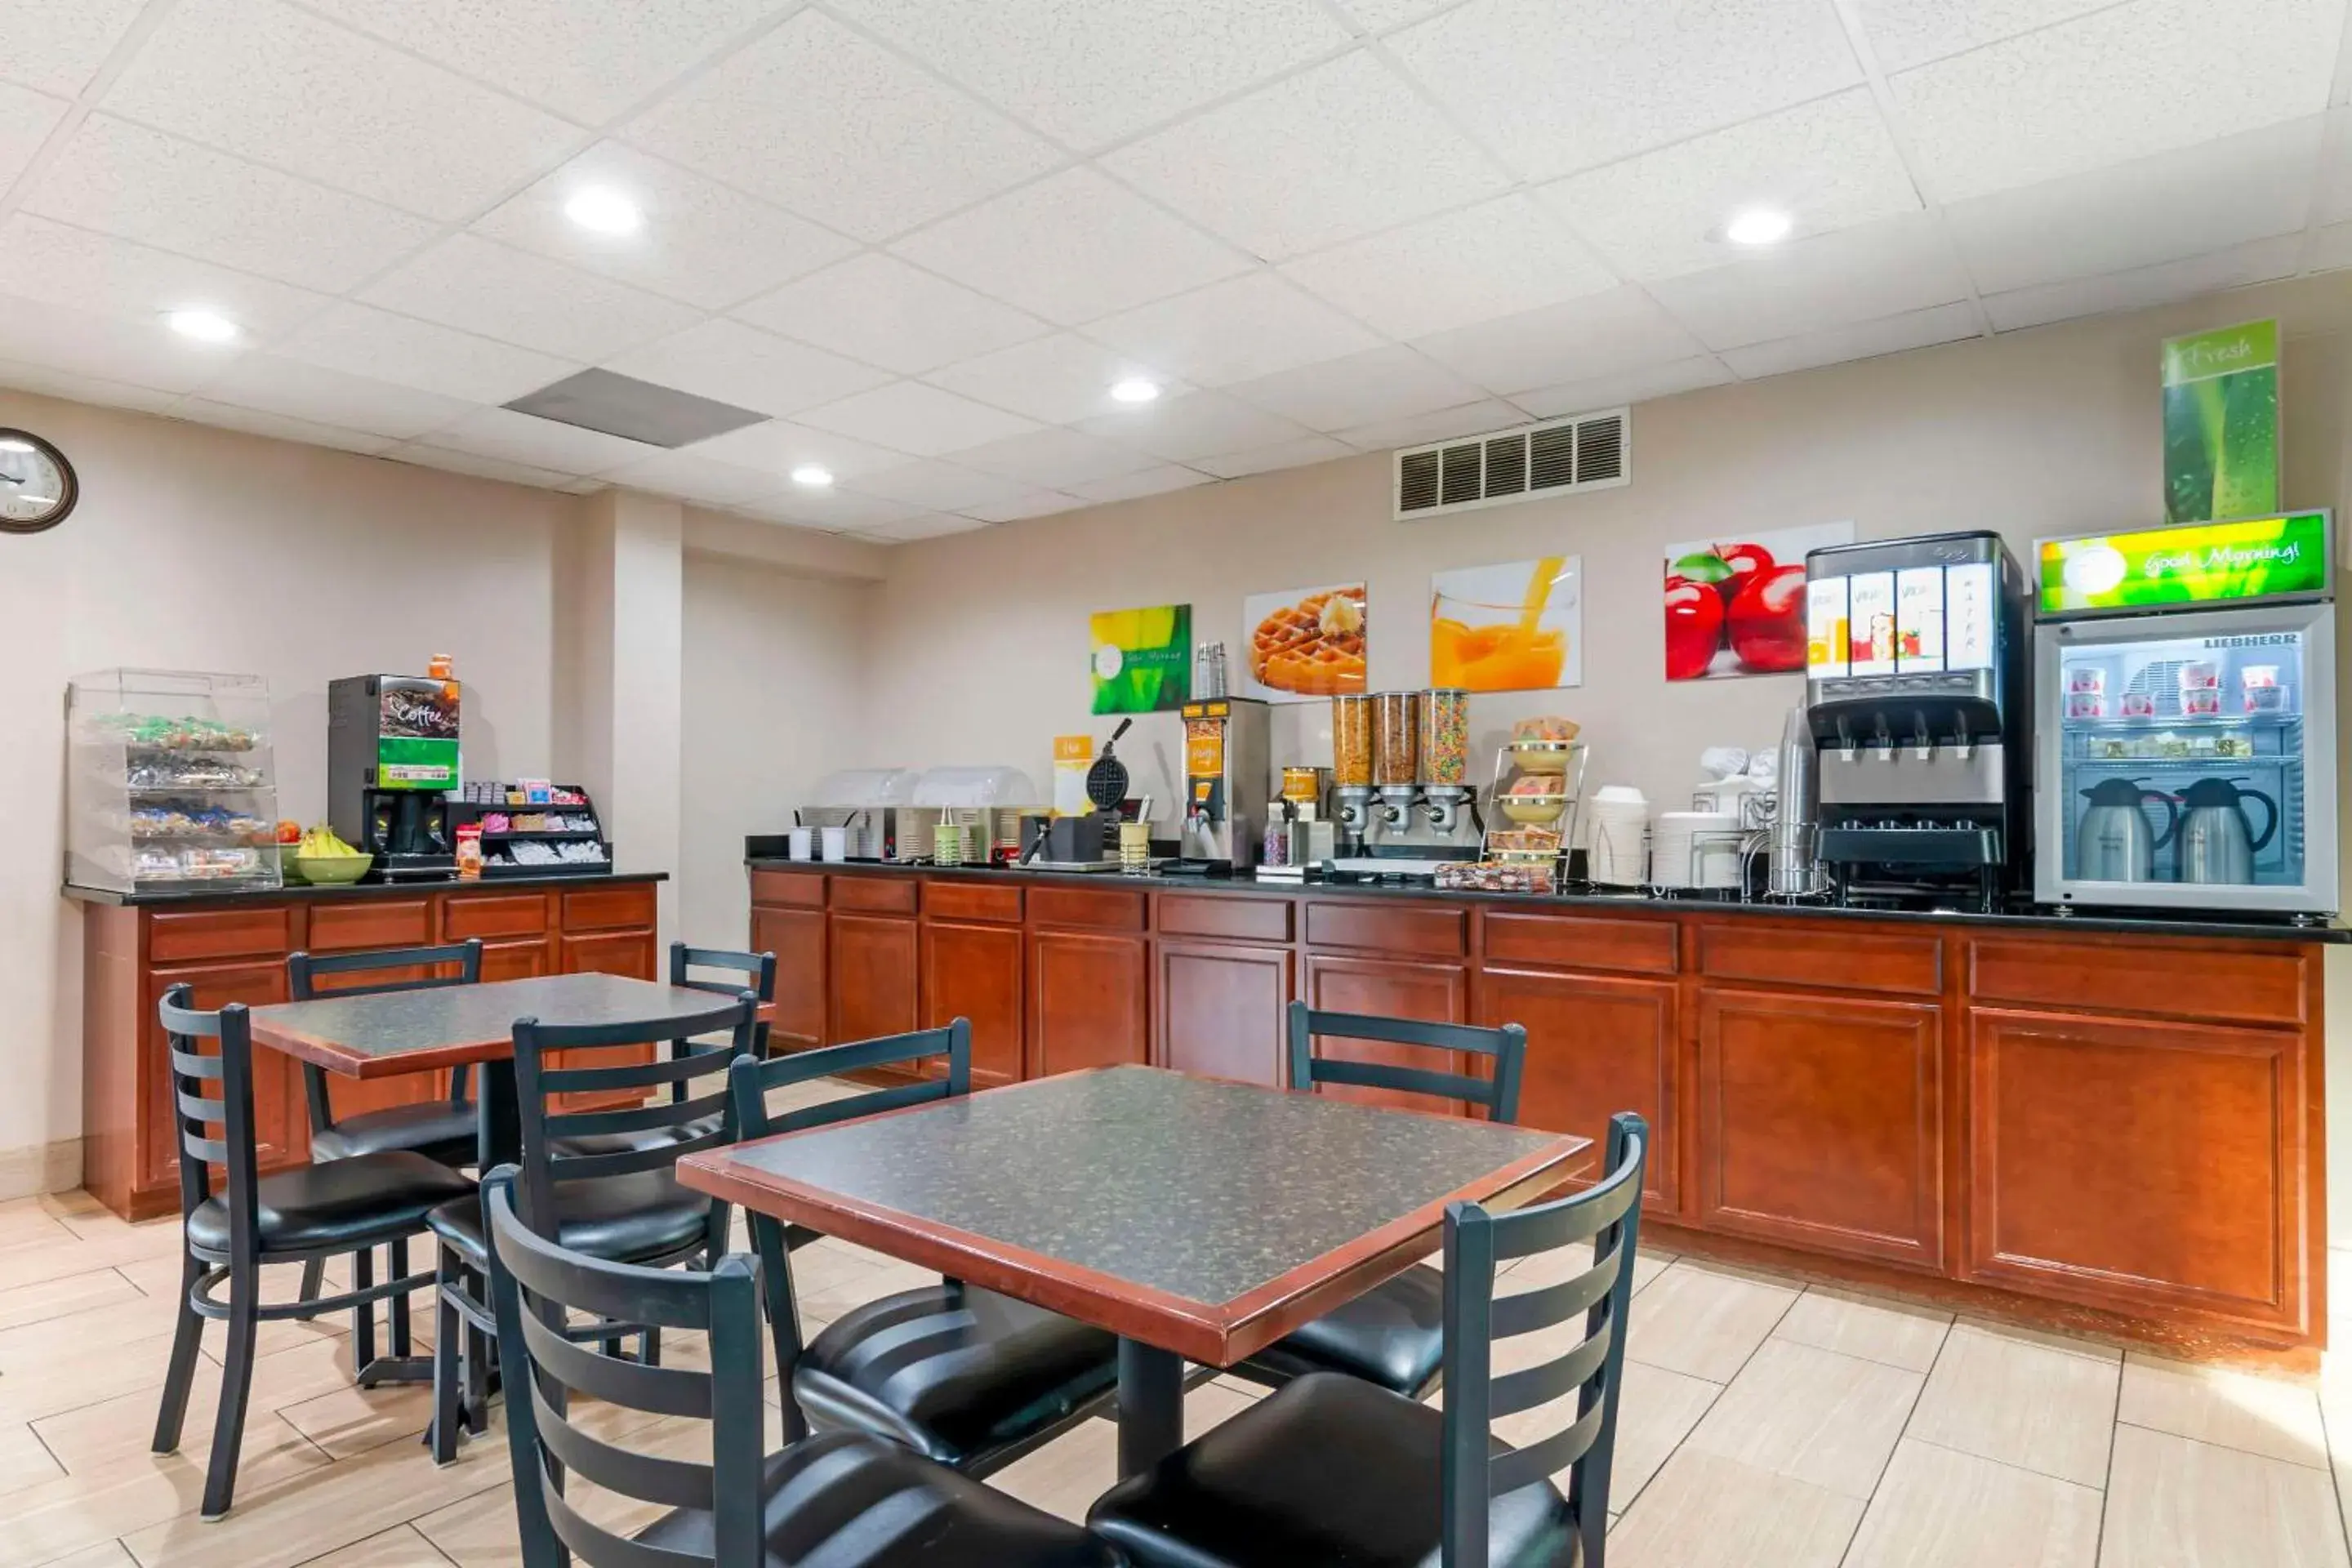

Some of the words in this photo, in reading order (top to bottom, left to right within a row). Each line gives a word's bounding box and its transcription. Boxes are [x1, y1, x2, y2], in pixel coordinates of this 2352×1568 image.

[2185, 336, 2253, 367] Fresh
[2145, 552, 2192, 577] Good
[2201, 541, 2300, 568] Morning!
[2204, 634, 2297, 648] LIEBHERR
[398, 705, 442, 726] Coffee
